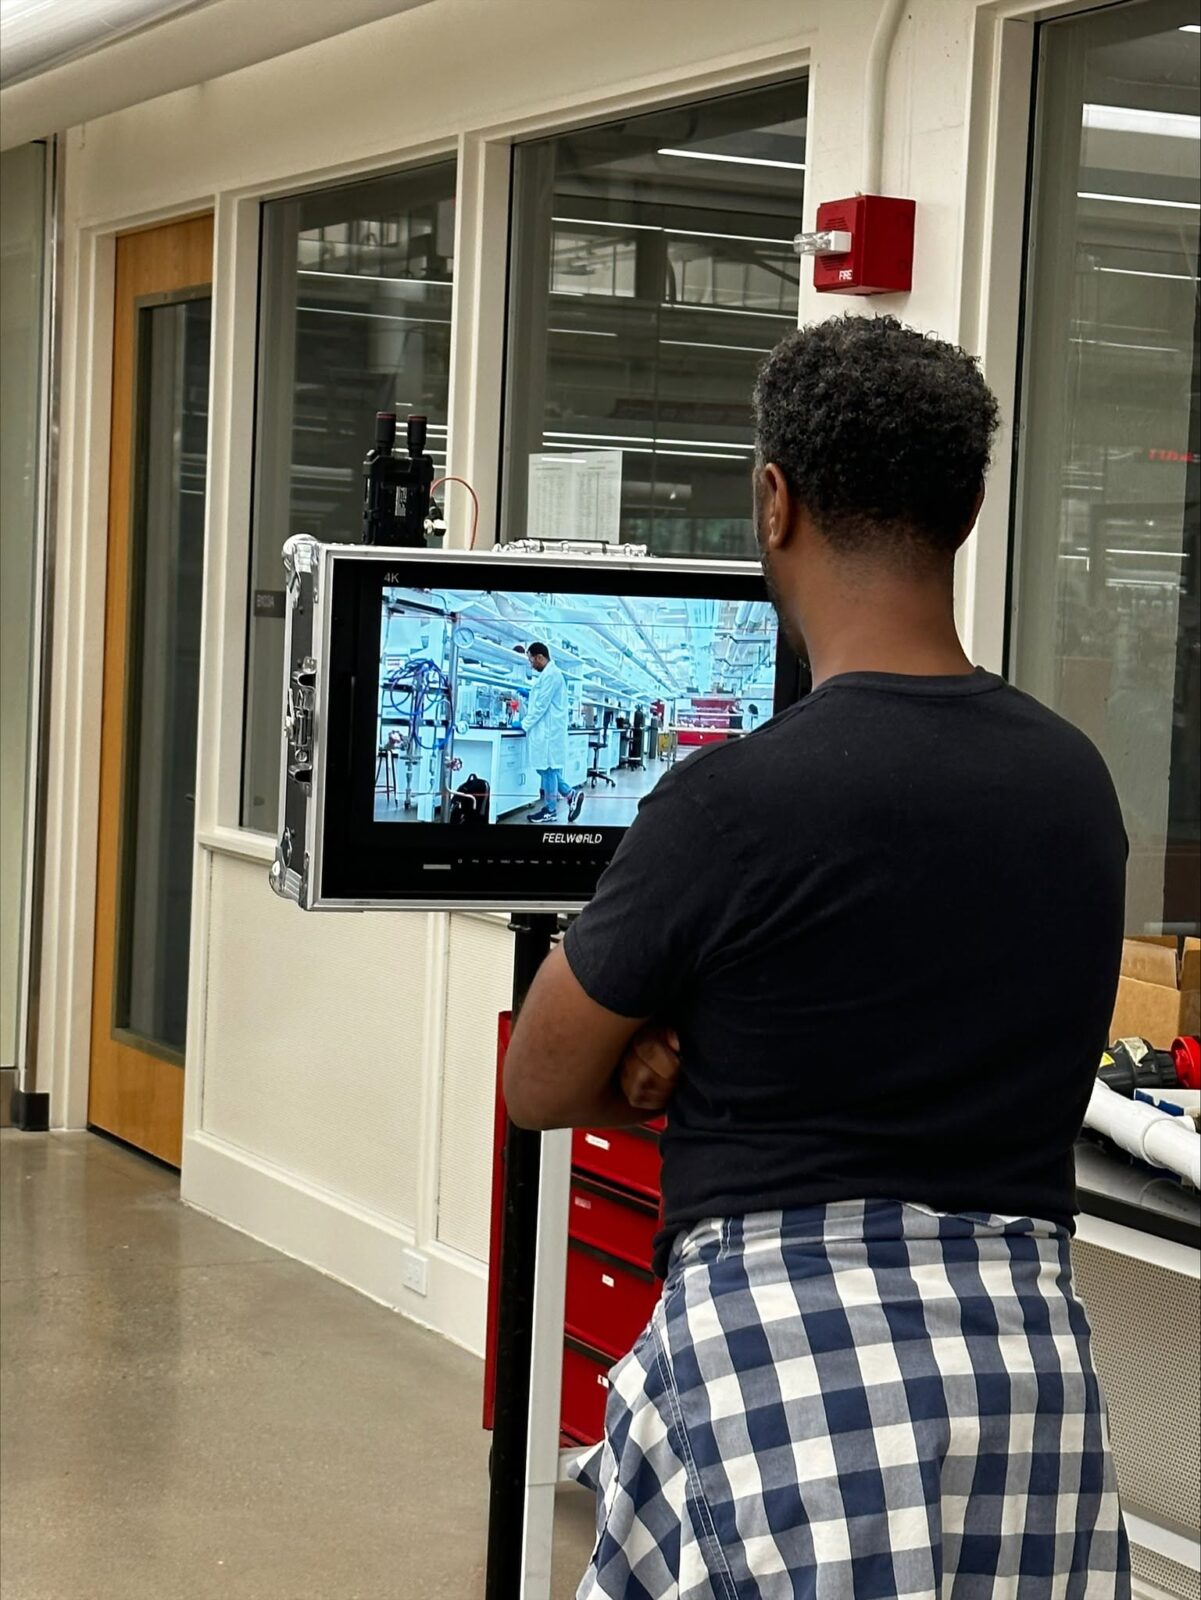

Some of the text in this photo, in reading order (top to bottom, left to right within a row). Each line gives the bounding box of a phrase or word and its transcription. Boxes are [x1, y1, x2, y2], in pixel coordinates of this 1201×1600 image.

[838, 269, 853, 280] FIRE
[384, 572, 399, 583] 4K
[542, 832, 602, 844] FEELWORLD
